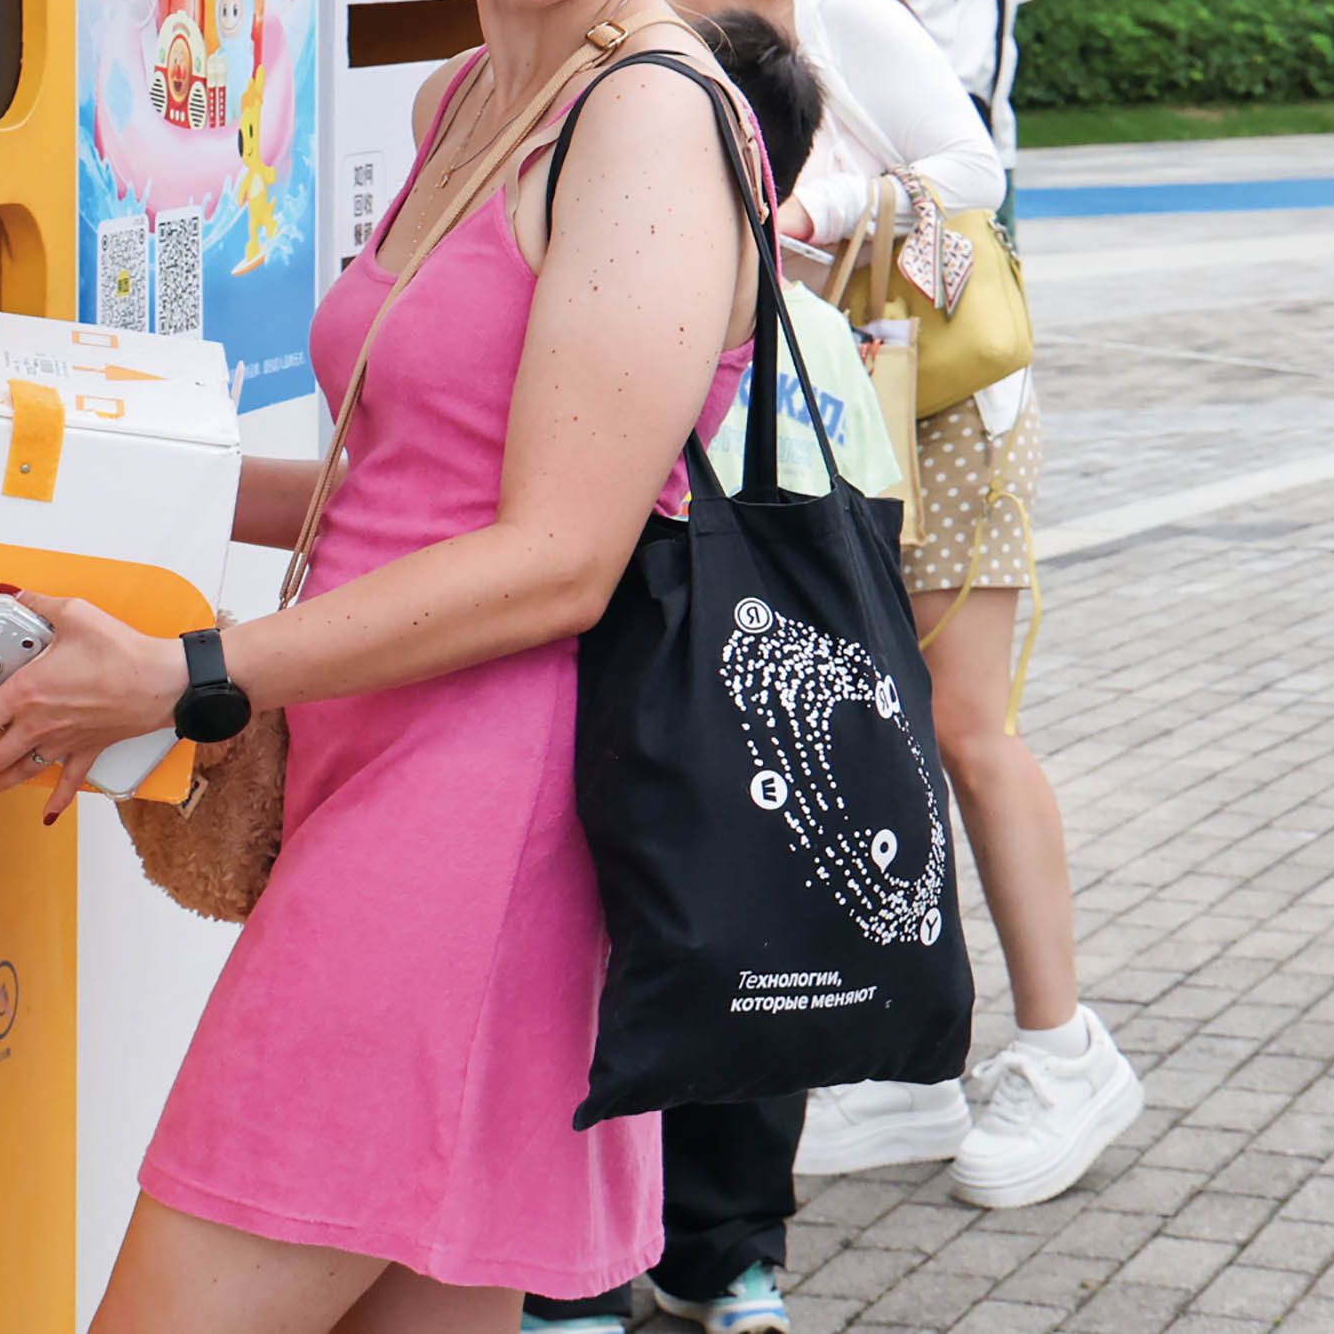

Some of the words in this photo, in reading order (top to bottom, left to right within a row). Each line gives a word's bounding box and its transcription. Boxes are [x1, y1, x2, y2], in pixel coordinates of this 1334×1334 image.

[739, 970, 843, 990] Технологии,
[730, 994, 809, 1015] которые
[811, 986, 878, 1009] меняют
